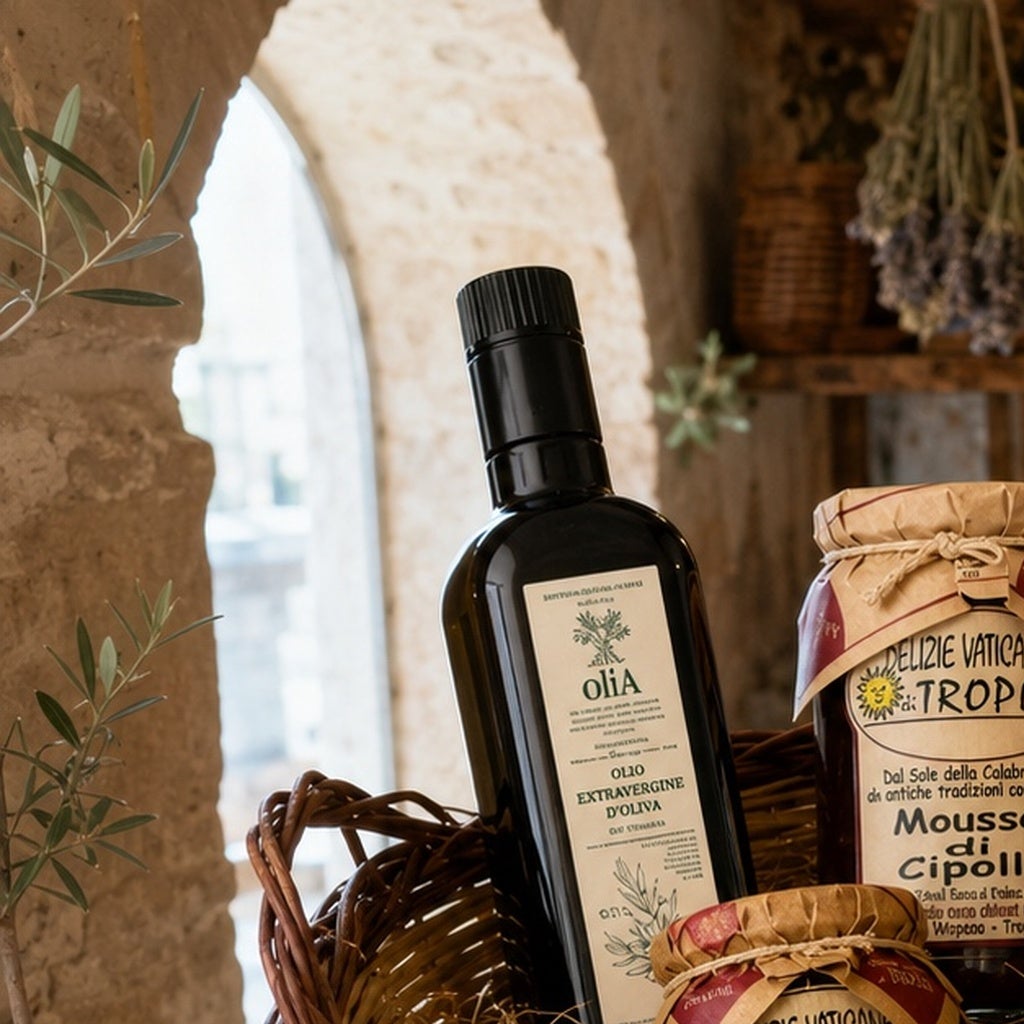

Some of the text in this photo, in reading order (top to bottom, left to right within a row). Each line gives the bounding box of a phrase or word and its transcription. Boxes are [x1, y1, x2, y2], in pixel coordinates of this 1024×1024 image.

[885, 634, 955, 672] DELIZIE
[582, 668, 642, 701] oliA
[611, 764, 645, 779] OLIO
[883, 768, 904, 785] Dal
[910, 767, 938, 783] Sole
[944, 764, 977, 781] della
[577, 777, 685, 804] EXTRAVERGINE
[885, 785, 932, 801] antiche
[938, 782, 1003, 799] tradizioni
[606, 800, 661, 820] D'OLIVA
[945, 836, 989, 856] di
